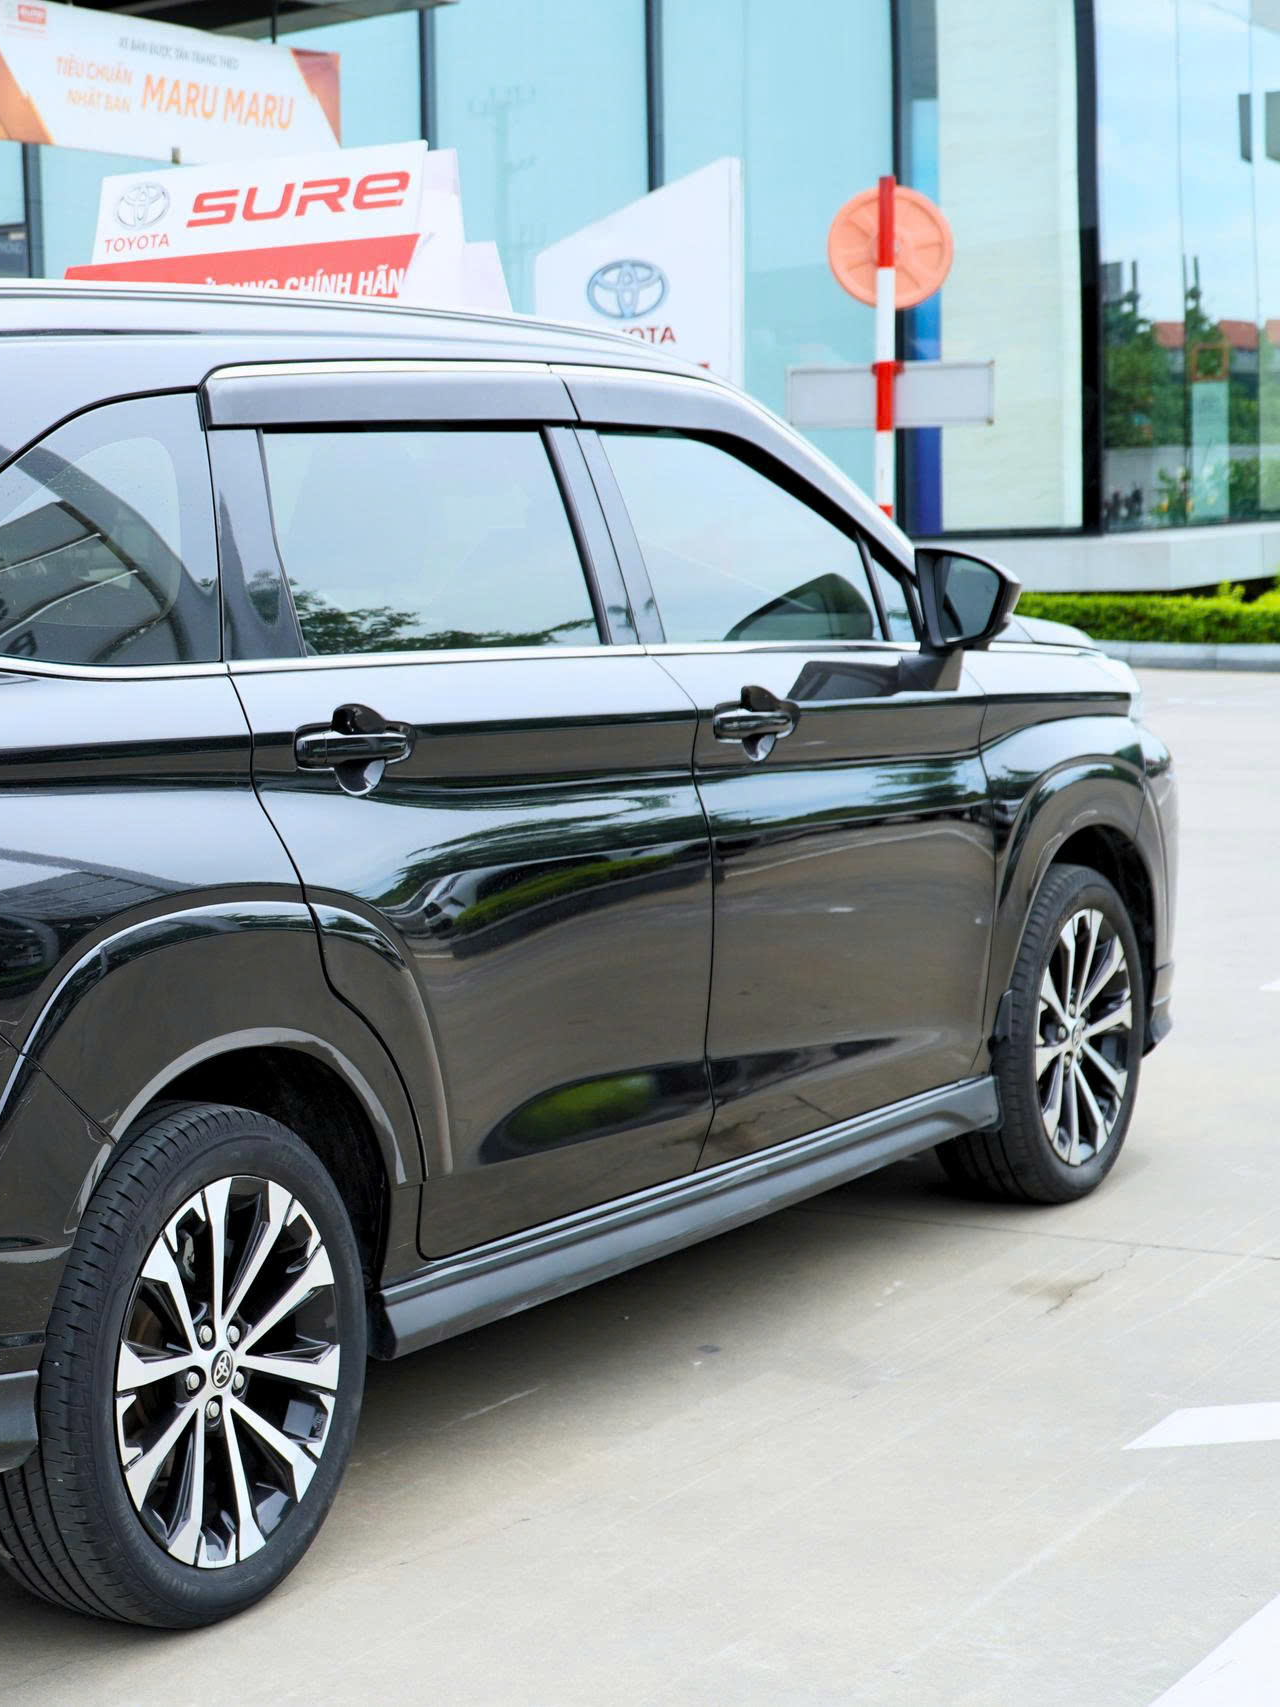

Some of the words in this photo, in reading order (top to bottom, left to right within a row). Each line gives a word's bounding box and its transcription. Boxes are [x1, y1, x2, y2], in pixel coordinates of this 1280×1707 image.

[141, 72, 218, 120] MARU
[223, 87, 296, 132] MARU
[104, 233, 170, 253] TOYOTA
